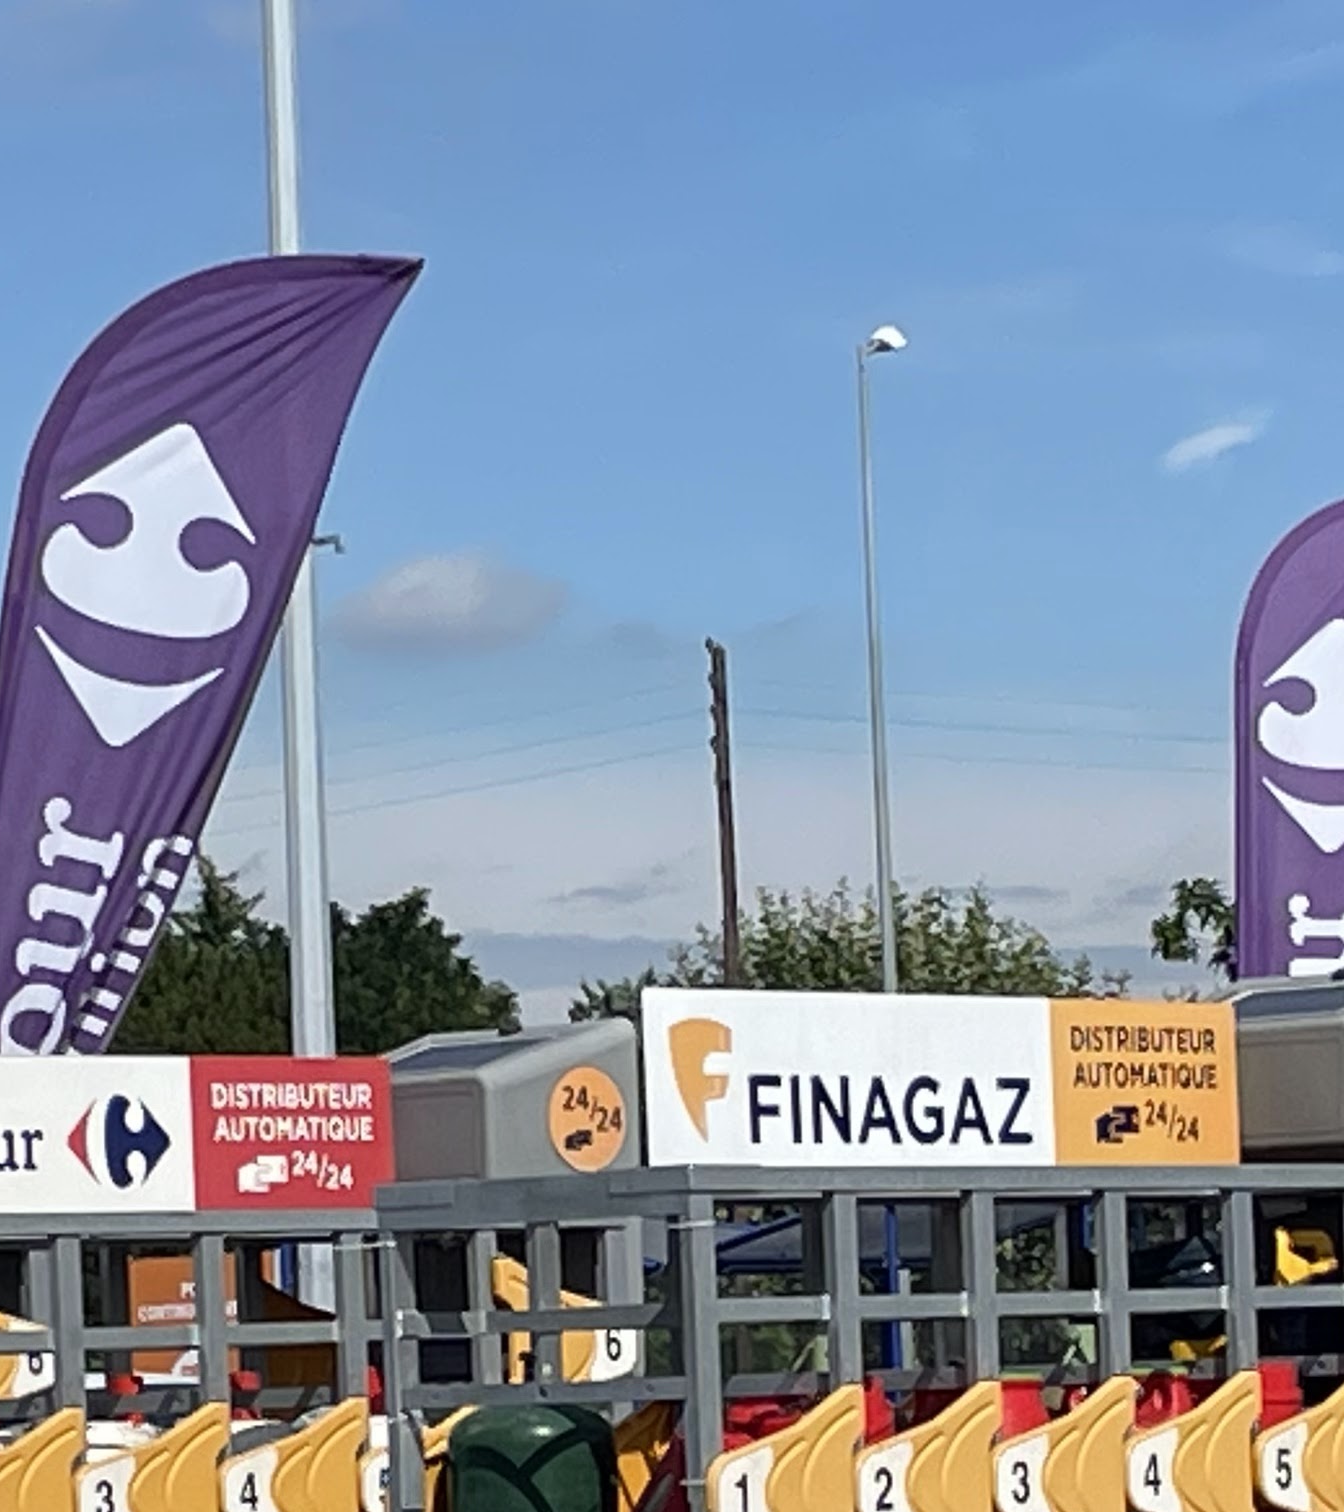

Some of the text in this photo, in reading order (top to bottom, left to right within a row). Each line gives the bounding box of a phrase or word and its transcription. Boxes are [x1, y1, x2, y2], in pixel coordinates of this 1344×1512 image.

[1069, 1024, 1217, 1055] DISTRIBUTEUR
[209, 1081, 373, 1110] DISTRIBUTEUR
[1072, 1061, 1218, 1090] AUTOMATIQUE
[213, 1114, 375, 1142] AUTOMATIQUE
[561, 1084, 622, 1133] 24/24
[746, 1073, 1035, 1146] FINAGAZ
[1144, 1098, 1200, 1142] 24/24
[290, 1149, 355, 1191] 24/24
[606, 1327, 622, 1361] 6
[874, 1467, 894, 1511] 2
[1011, 1461, 1031, 1504] 3
[1143, 1453, 1162, 1496] 4
[1275, 1448, 1292, 1489] 5
[239, 1472, 259, 1512] 4
